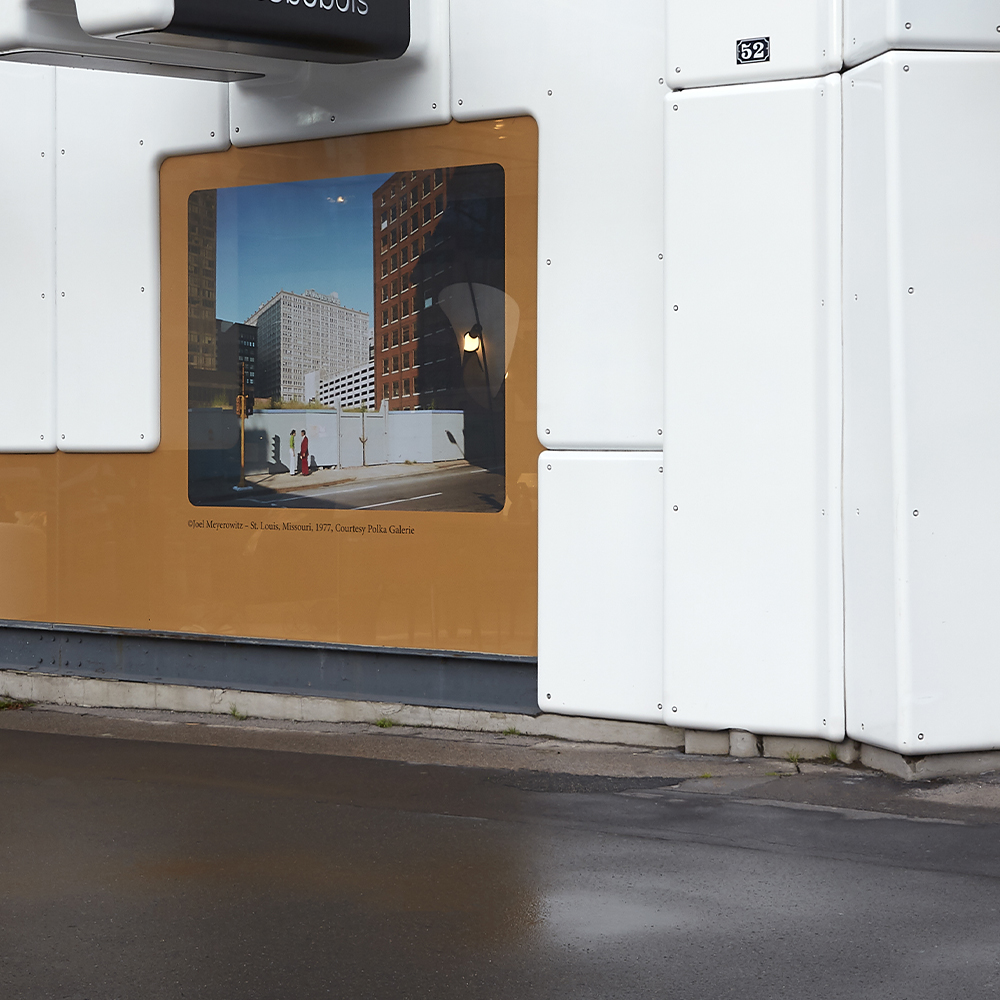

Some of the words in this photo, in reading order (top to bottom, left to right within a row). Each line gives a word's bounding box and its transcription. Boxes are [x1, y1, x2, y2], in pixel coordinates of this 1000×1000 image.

[741, 42, 764, 59] 52
[205, 519, 243, 532] Meyerowitz
[250, 521, 259, 530] St.
[282, 521, 314, 532] Missouri,
[316, 523, 334, 533] 1977,
[335, 523, 367, 535] Courtesy
[368, 523, 387, 534] Polka
[389, 524, 415, 535] Galerie
